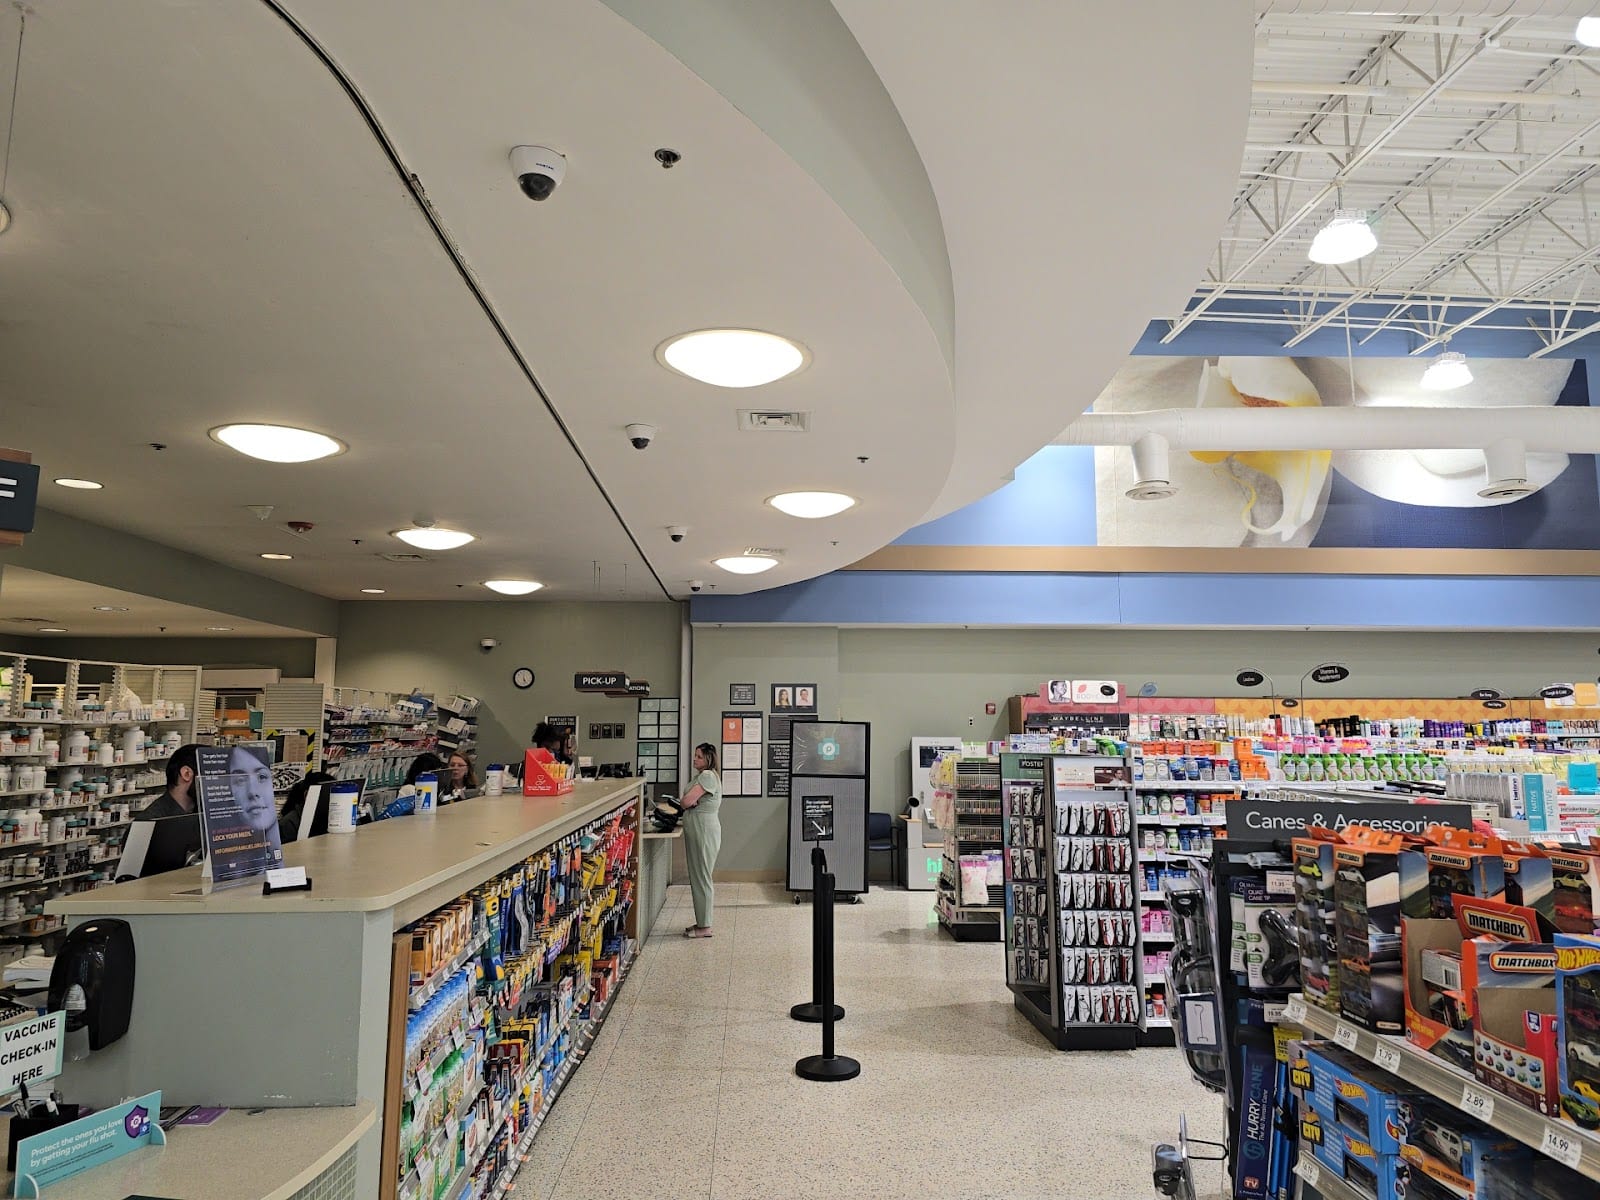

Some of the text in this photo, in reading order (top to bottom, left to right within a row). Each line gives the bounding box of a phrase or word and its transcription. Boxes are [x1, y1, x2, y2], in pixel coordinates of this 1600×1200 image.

[582, 677, 617, 685] PICK-UP
[1245, 811, 1306, 829] Canes
[1312, 813, 1327, 827] &
[1431, 854, 1465, 866] MATCHBOX
[1468, 913, 1526, 938] MATCHBOX
[1498, 957, 1555, 968] MATCHBOX
[1557, 948, 1576, 968] HOT
[5, 1018, 56, 1042] VACCINE
[1337, 1027, 1350, 1040] 8.89
[1, 1038, 57, 1065] CHECK-IN
[1379, 1049, 1393, 1062] 1.79
[12, 1065, 43, 1085] HERE
[1292, 1070, 1311, 1087] CITY
[1466, 1093, 1484, 1108] 2.89
[31, 1118, 123, 1158] Protect the ones you love
[1302, 1126, 1321, 1142] CITY
[1548, 1134, 1569, 1151] 14.99
[30, 1128, 118, 1167] by getting your flu shot.
